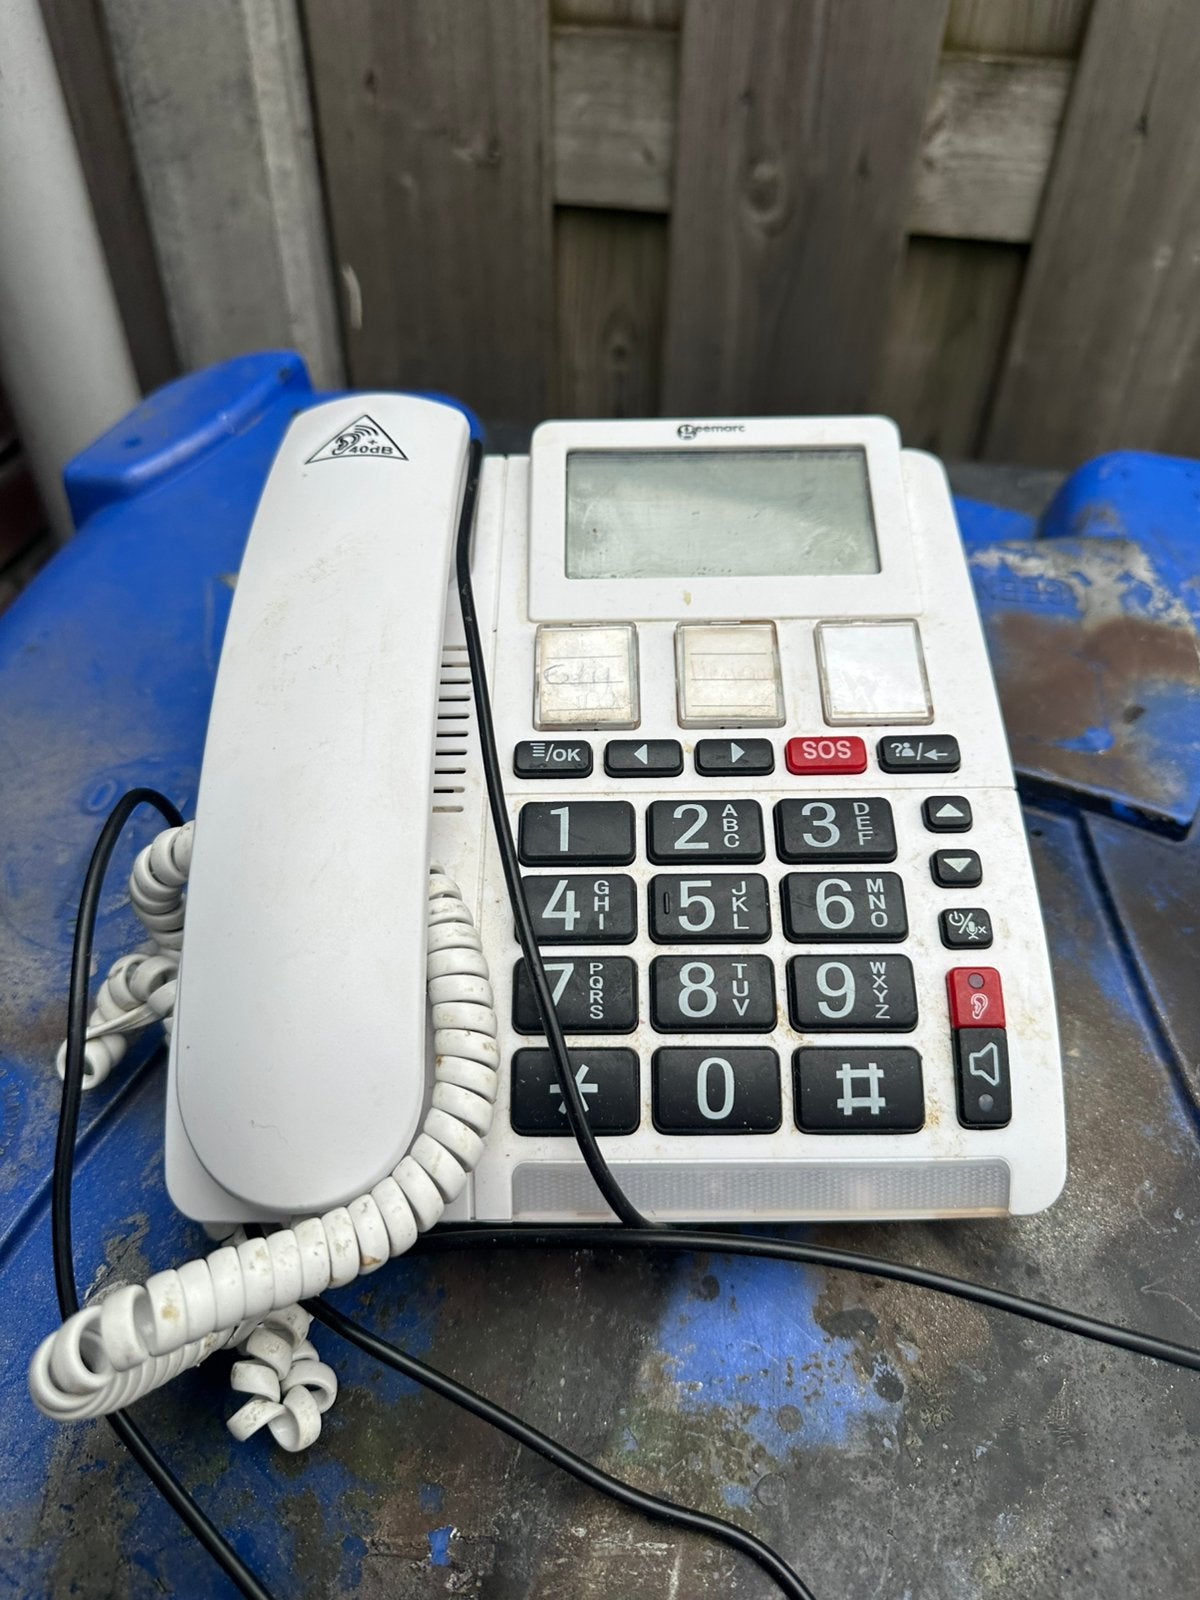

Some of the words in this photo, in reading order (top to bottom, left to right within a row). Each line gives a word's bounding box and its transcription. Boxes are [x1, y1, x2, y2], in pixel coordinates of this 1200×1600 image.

[349, 445, 393, 455] 40dB
[801, 740, 851, 760] SOS
[550, 806, 570, 852] 1
[673, 803, 710, 850] 2
[721, 803, 740, 848] ABC
[801, 802, 841, 848] 3
[853, 802, 874, 846] DEF
[541, 879, 581, 931] 4
[593, 880, 610, 930] GHI
[678, 880, 716, 932] 5
[731, 880, 750, 930] JKL
[815, 878, 855, 930] 6
[865, 878, 889, 928] MNO
[543, 962, 575, 1007] 7
[589, 962, 604, 1020] PQRS
[678, 961, 718, 1018] 8
[731, 962, 750, 1017] TUV
[815, 961, 856, 1019] 9
[869, 961, 891, 1019] WXYZ
[696, 1056, 735, 1120] 0
[835, 1062, 886, 1116] #
